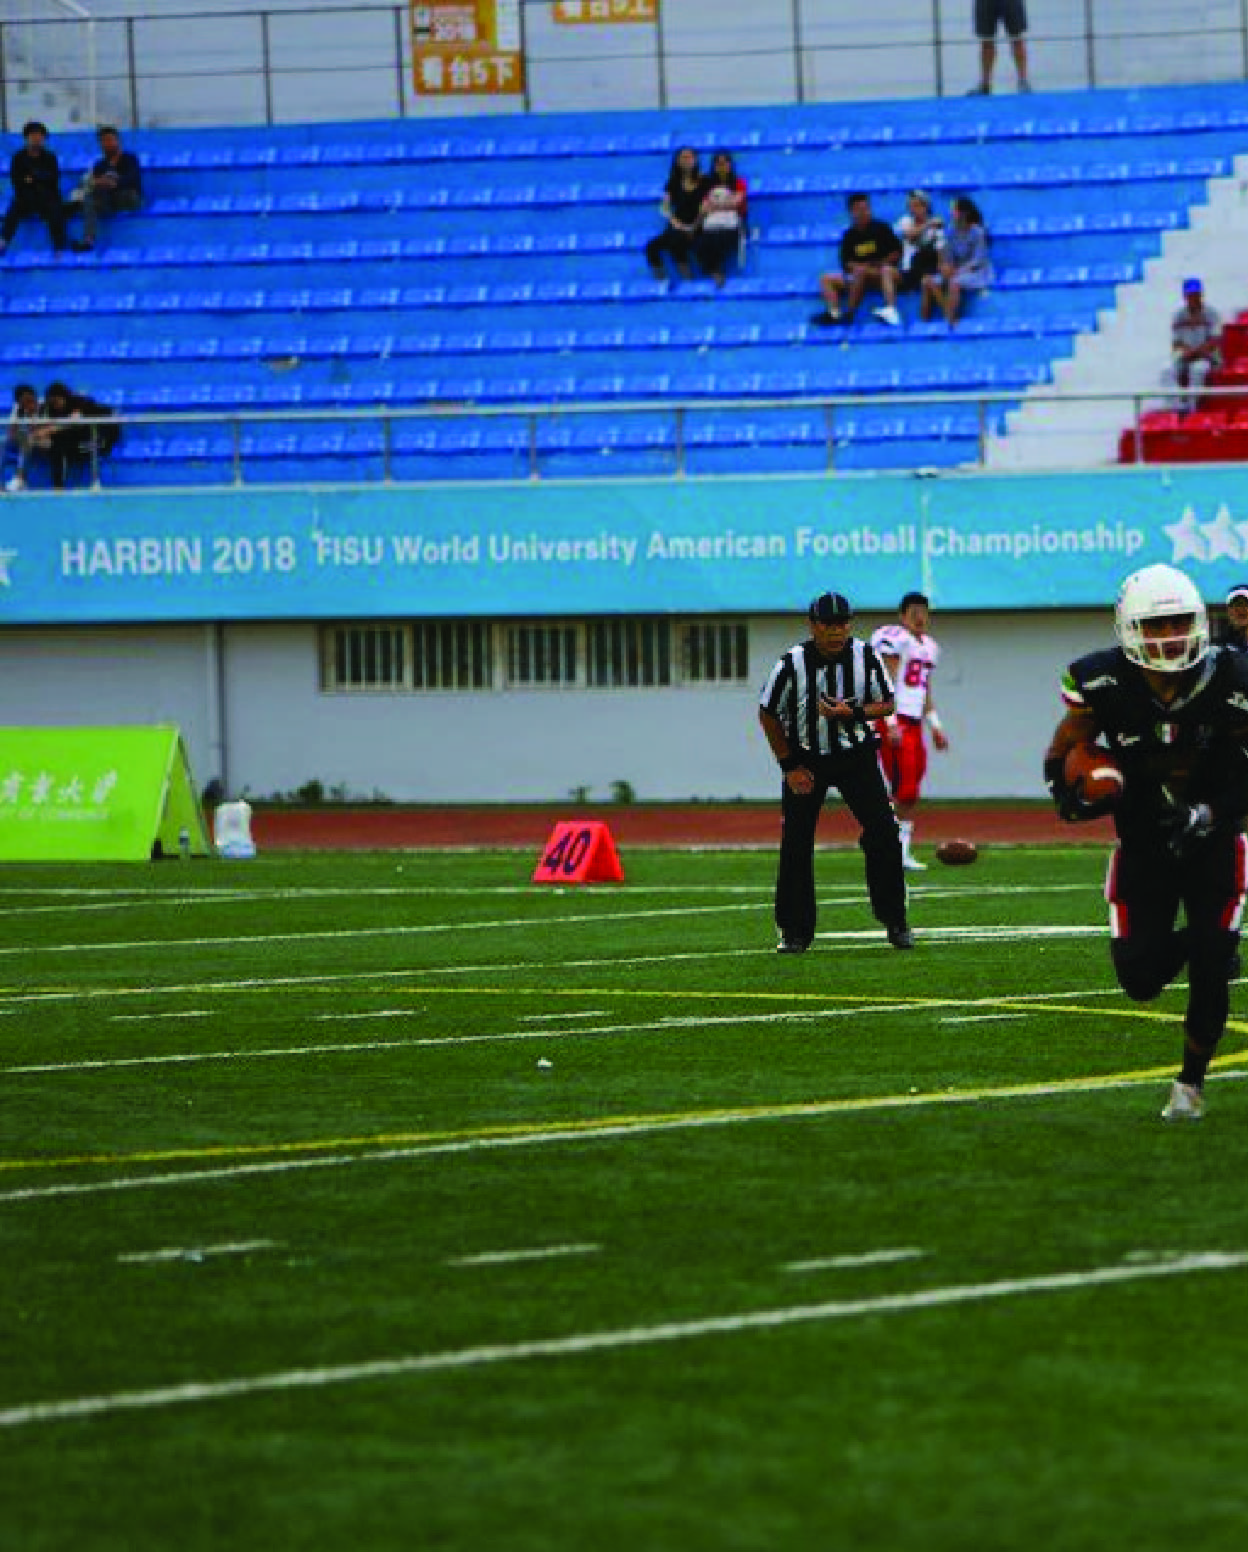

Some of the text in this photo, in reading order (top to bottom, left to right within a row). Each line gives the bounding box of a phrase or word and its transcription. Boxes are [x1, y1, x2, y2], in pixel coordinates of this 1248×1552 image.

[61, 535, 297, 577] HARBIN 2018
[317, 520, 1145, 567] FISU World University American Football Championship
[544, 828, 591, 875] 40
